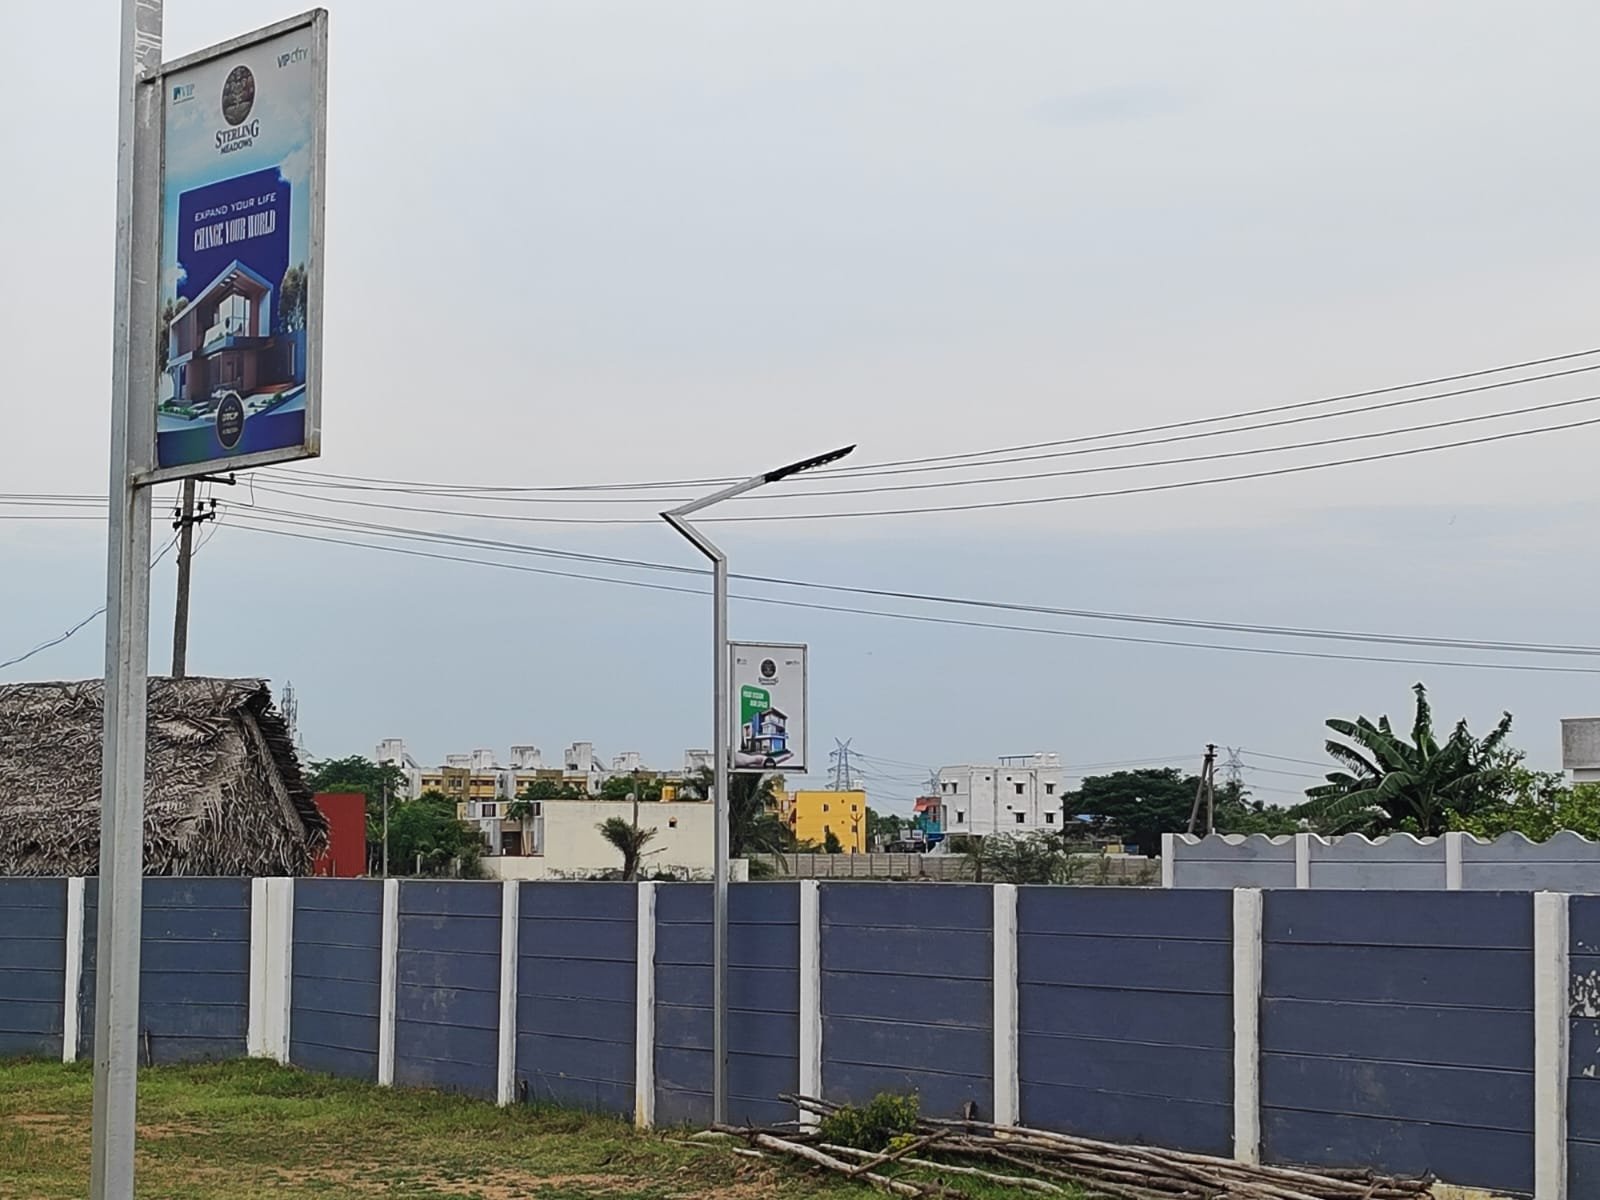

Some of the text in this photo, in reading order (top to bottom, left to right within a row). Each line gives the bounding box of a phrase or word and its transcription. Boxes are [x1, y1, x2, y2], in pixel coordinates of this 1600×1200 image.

[277, 53, 290, 68] VIP
[215, 119, 260, 149] STERLING
[220, 138, 253, 154] MEADOWS
[195, 192, 277, 222] EXPAND YOUR LIFE
[194, 210, 275, 251] CHANGE YOUR WORLD
